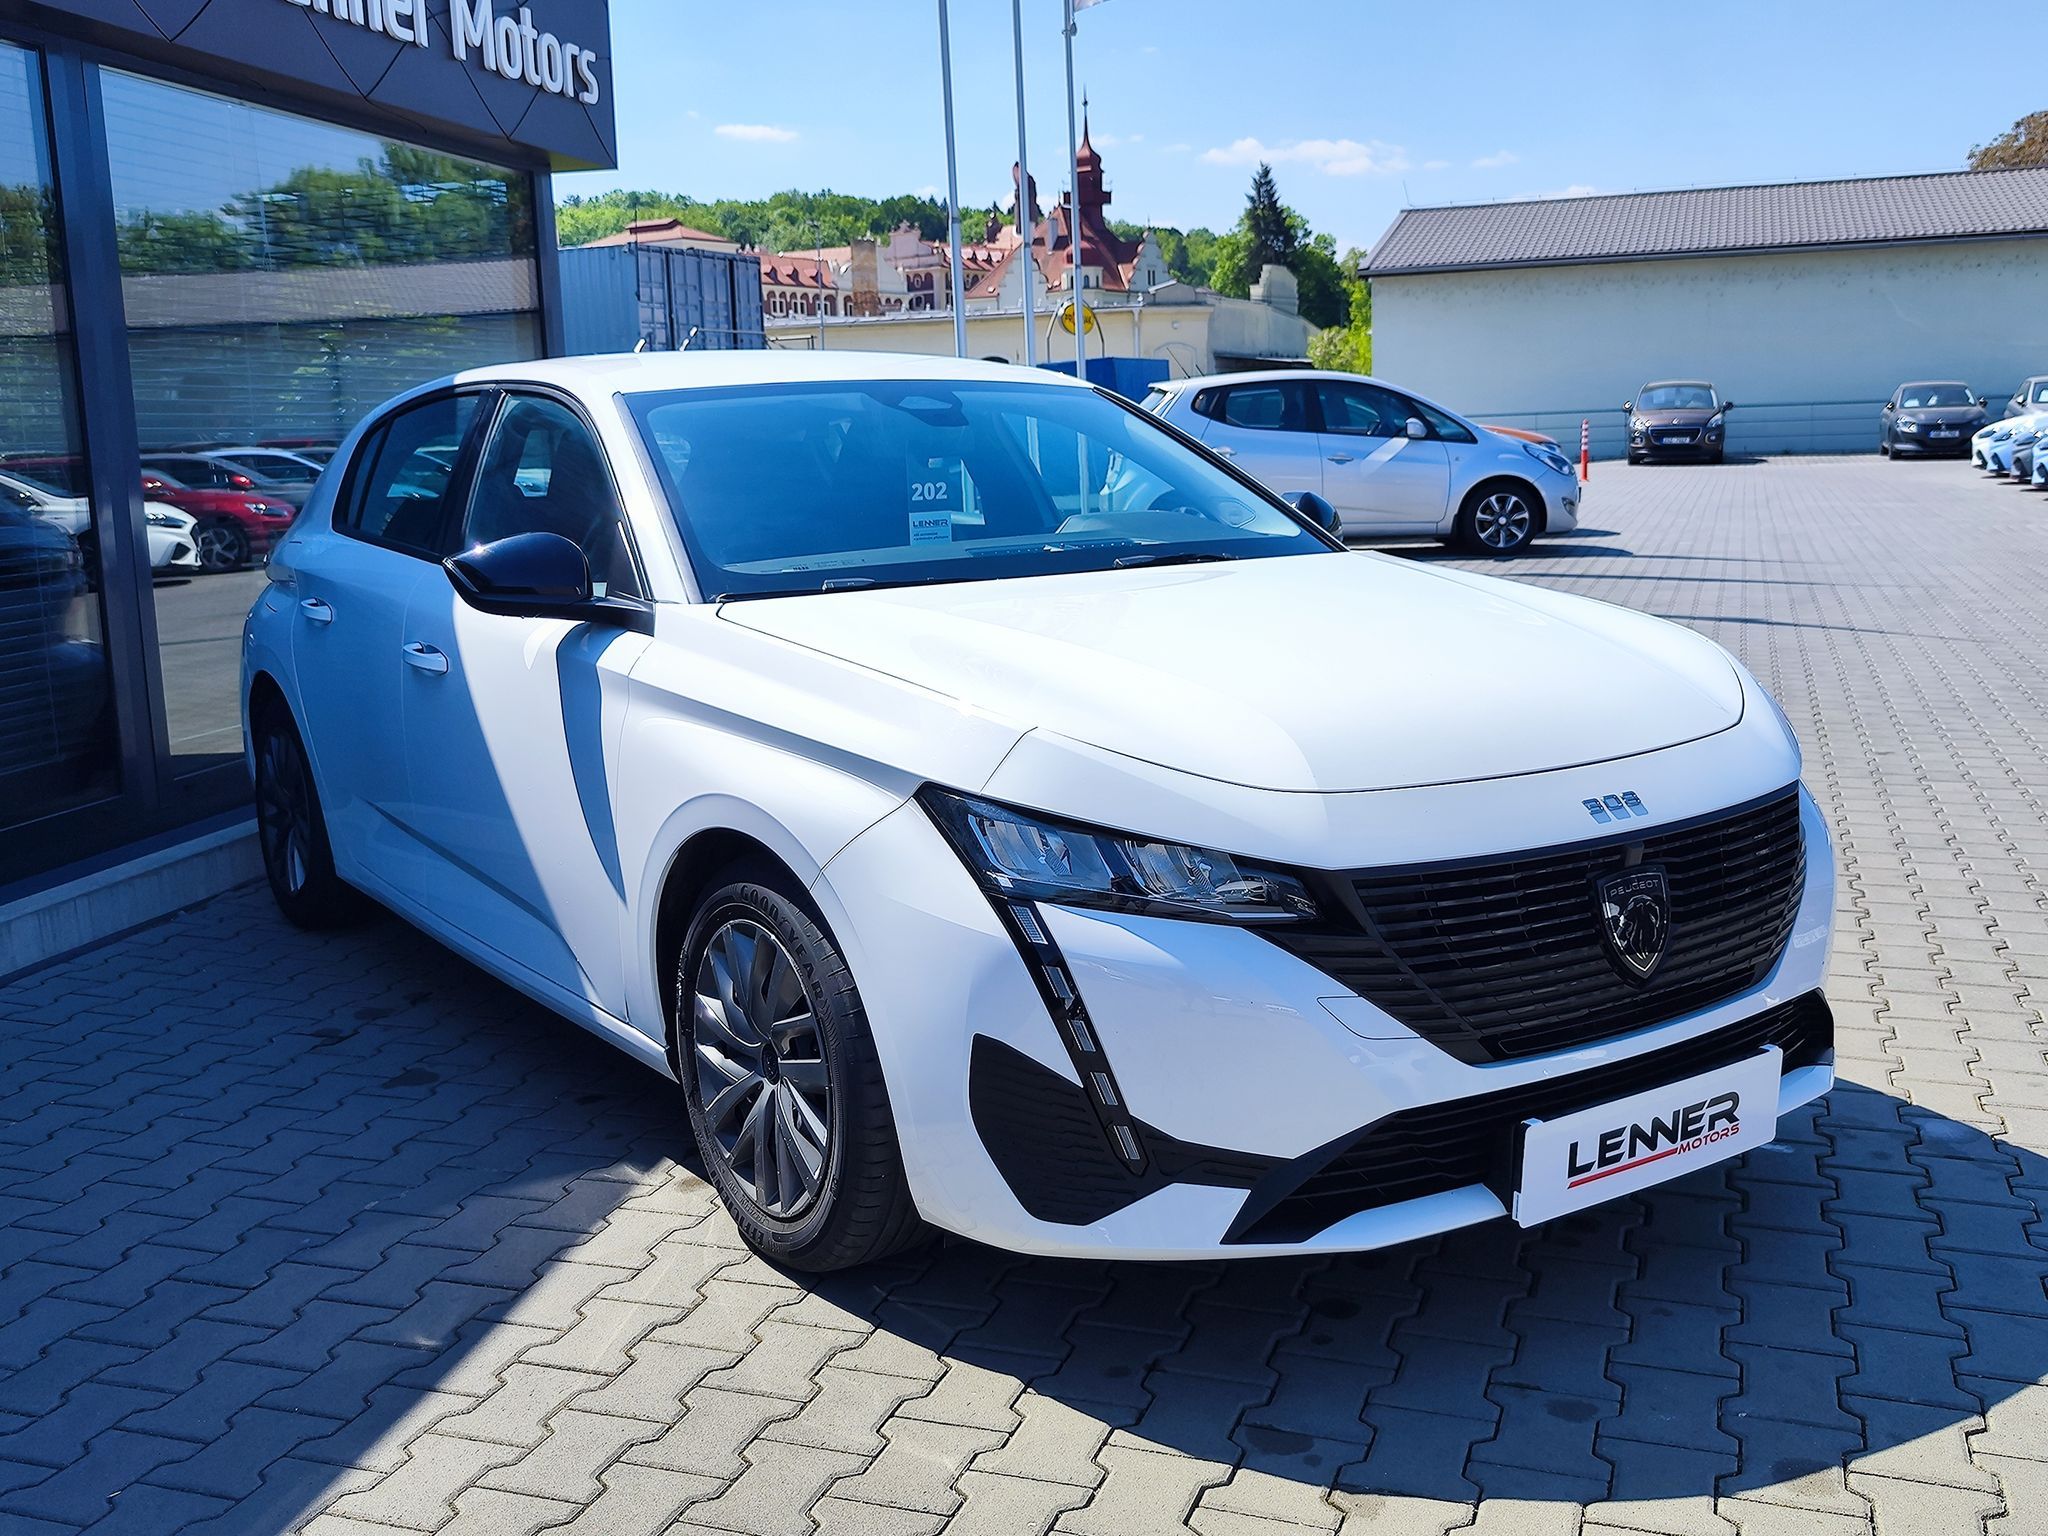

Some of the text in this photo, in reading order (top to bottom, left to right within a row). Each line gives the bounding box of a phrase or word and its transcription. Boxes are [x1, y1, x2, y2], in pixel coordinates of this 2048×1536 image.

[449, 0, 600, 105] Motors
[911, 482, 948, 501] 202
[1609, 879, 1659, 897] PEUGEOT
[1567, 1091, 1740, 1179] LENNER
[1677, 1123, 1740, 1155] MOTORS
